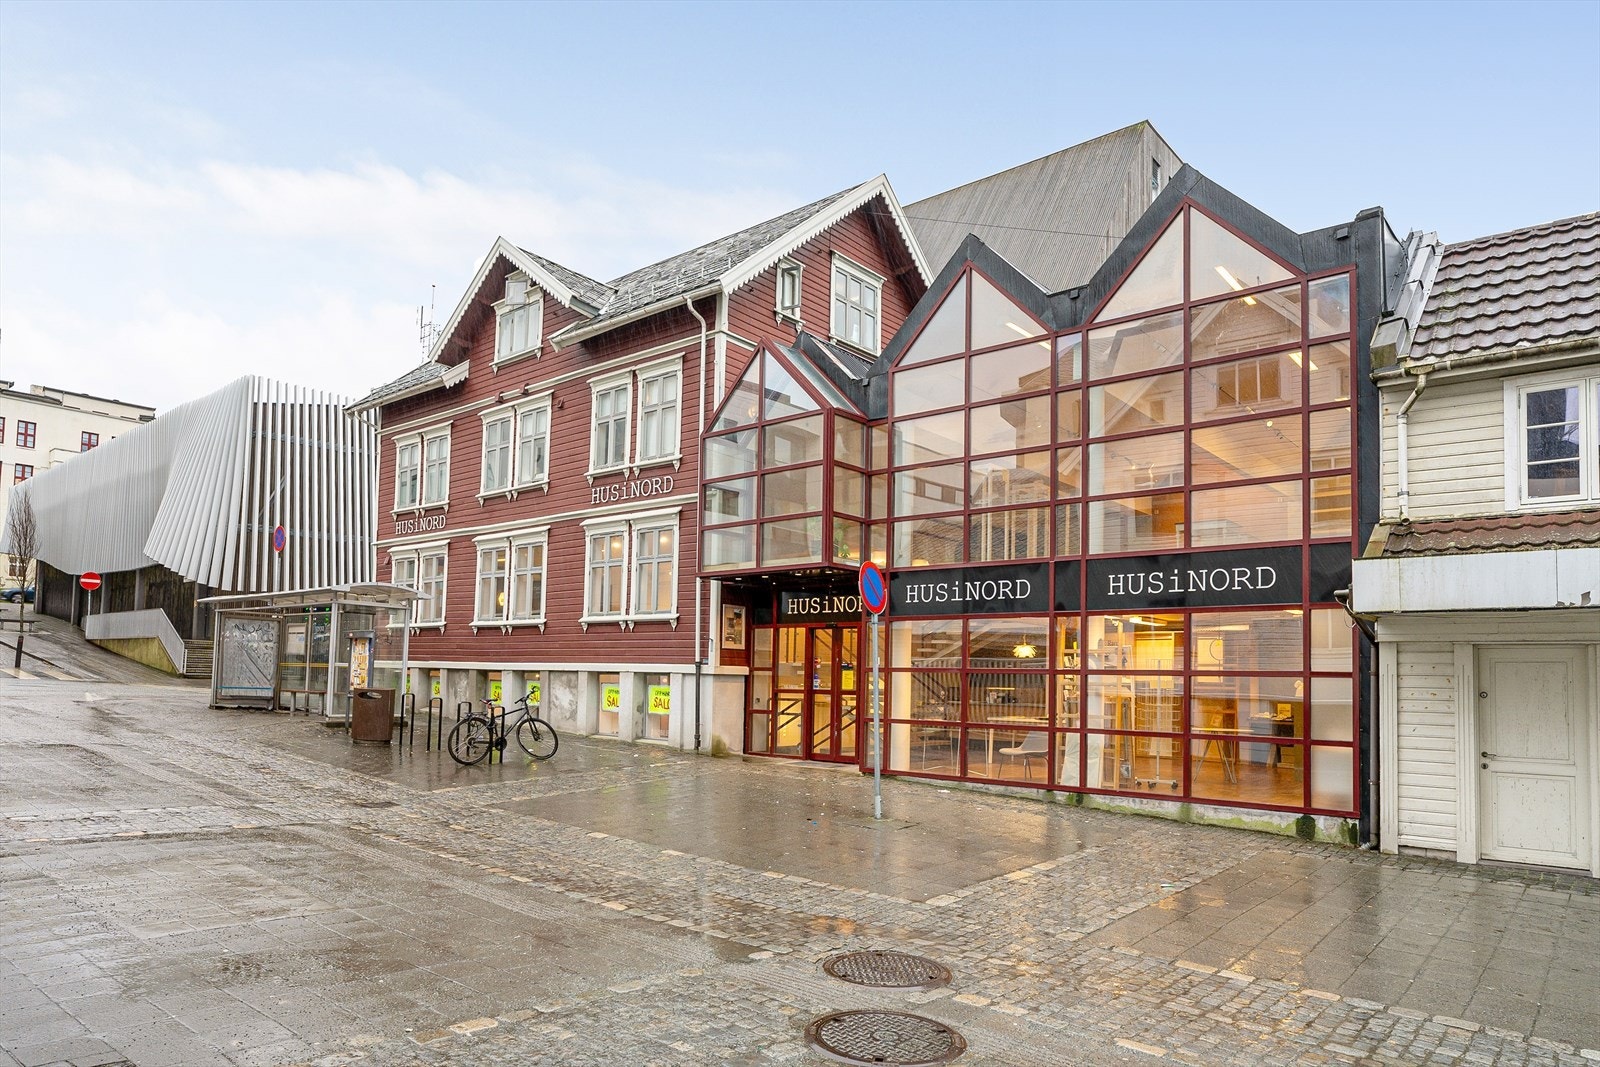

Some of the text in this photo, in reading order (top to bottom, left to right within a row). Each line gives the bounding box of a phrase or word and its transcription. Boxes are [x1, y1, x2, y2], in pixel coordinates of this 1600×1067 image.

[591, 475, 674, 505] HUSiNORD
[395, 514, 446, 535] HUSiNORD
[905, 579, 1031, 603] HUSiNORD
[1107, 566, 1277, 596] HUSiNORD
